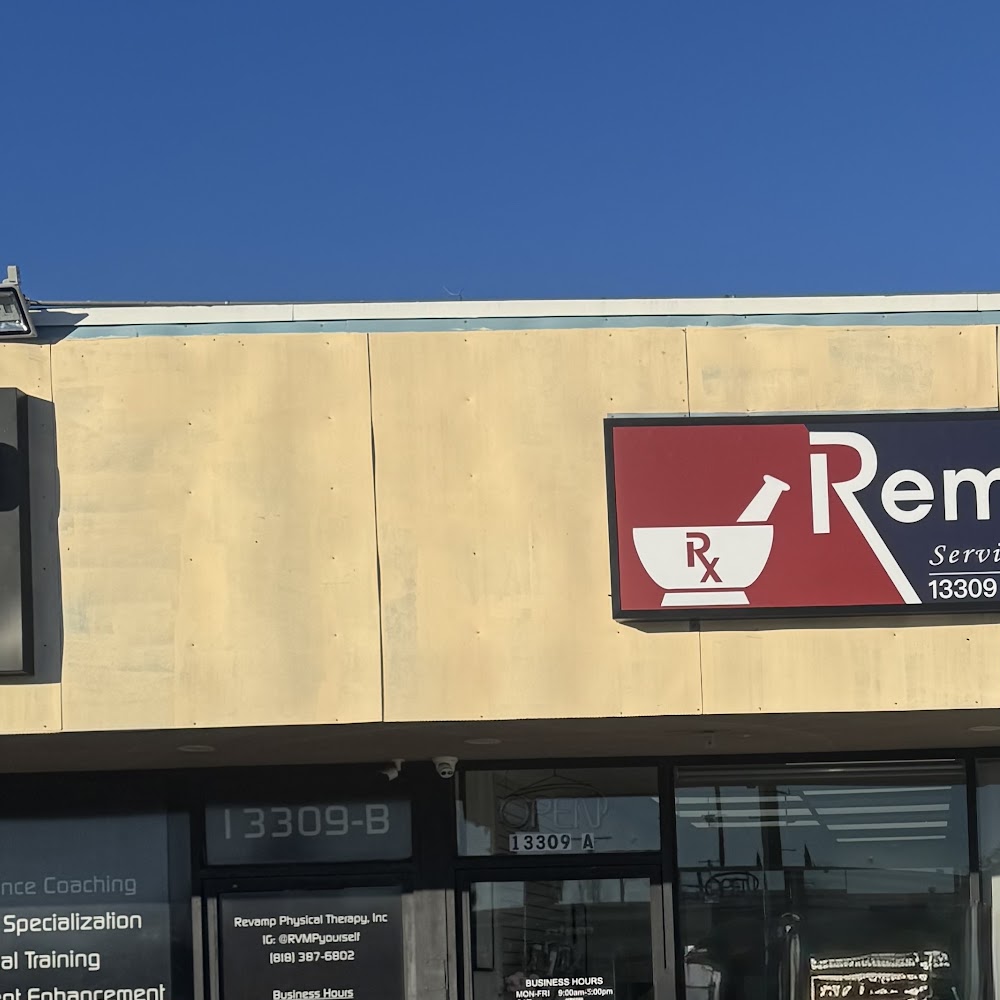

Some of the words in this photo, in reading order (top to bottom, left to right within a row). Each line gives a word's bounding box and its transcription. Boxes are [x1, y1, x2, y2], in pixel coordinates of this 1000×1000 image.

[686, 532, 723, 583] Rx
[928, 578, 998, 600] 13309
[224, 804, 390, 840] 13309-B
[512, 834, 571, 851] 13309
[582, 833, 594, 849] A
[44, 875, 137, 896] Coaching
[3, 912, 143, 936] Specialization
[233, 917, 277, 928] Revamp
[279, 914, 323, 927] Physical
[372, 912, 388, 923] Inc
[262, 934, 276, 945] IG:
[278, 932, 361, 945] @RVMPyourself
[24, 950, 101, 971] Training
[270, 951, 295, 964] (818)
[298, 950, 355, 962] 387-6802
[525, 978, 570, 987] BUSINESS
[572, 976, 604, 986] HOURS
[272, 989, 320, 1000] Business
[323, 988, 354, 1000] Hours
[516, 989, 551, 998] MON-FRI
